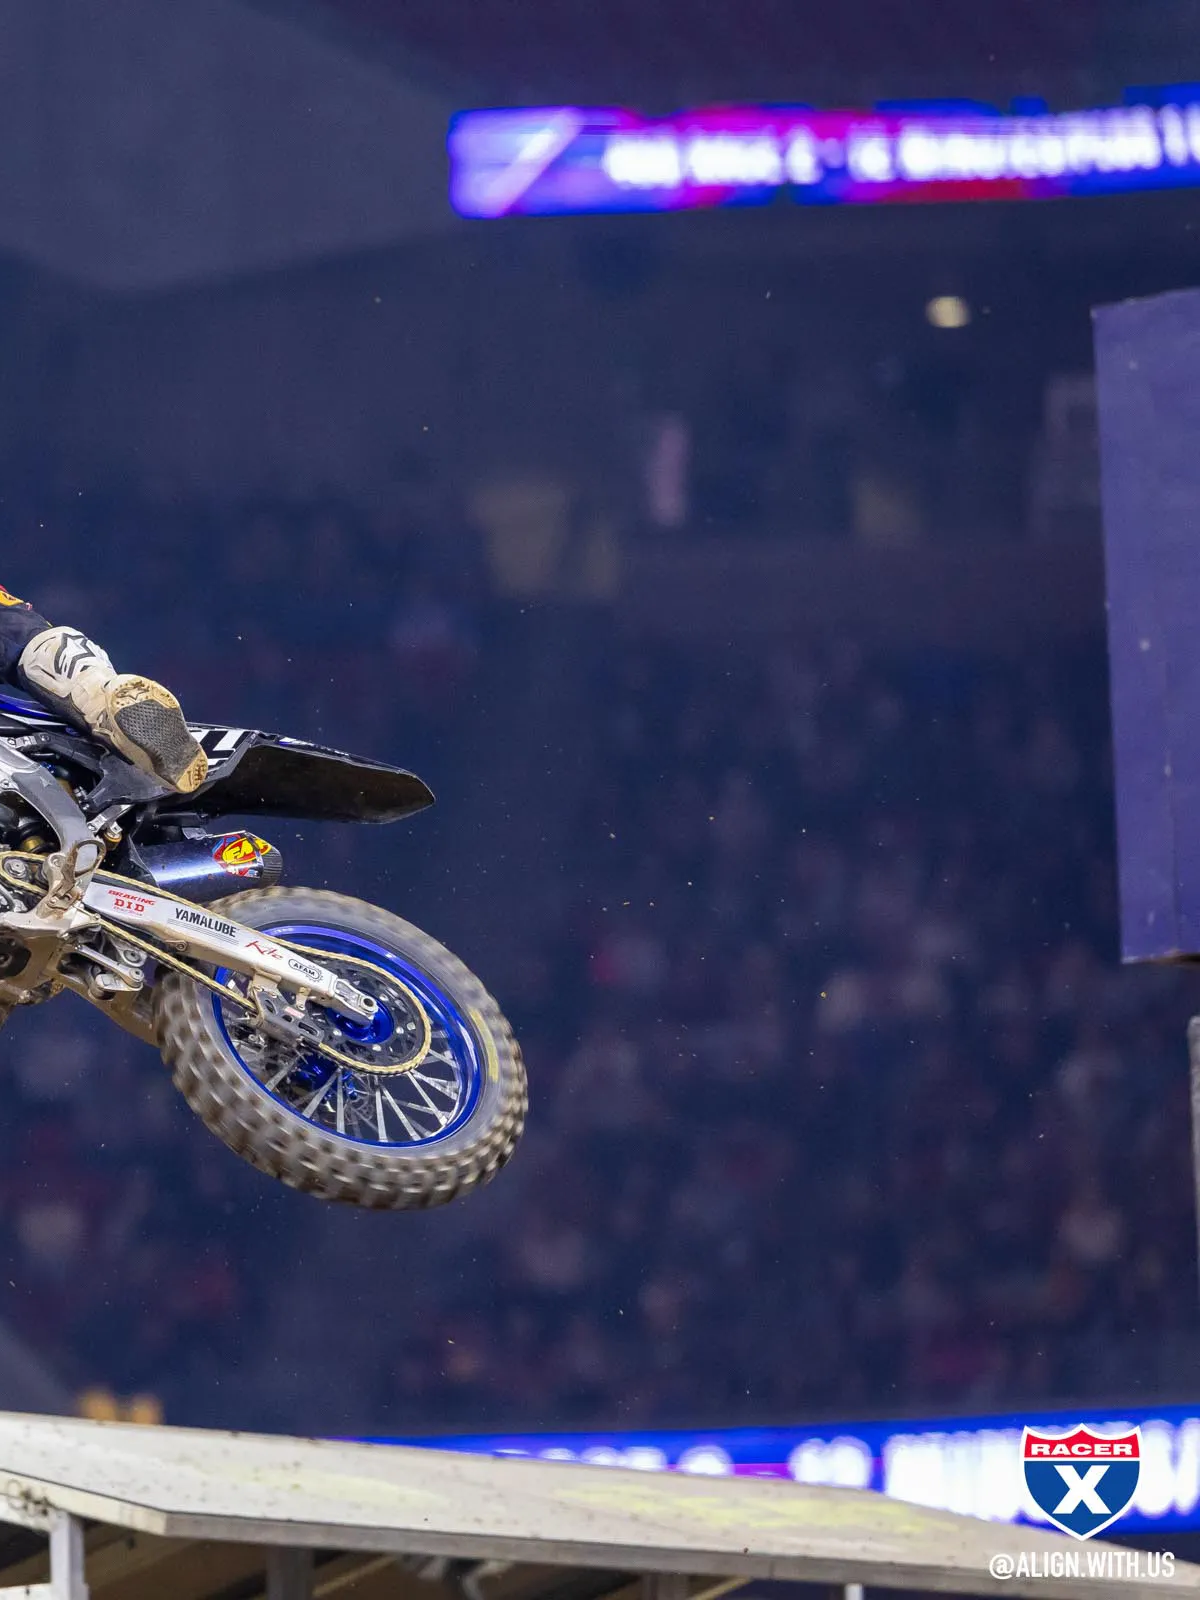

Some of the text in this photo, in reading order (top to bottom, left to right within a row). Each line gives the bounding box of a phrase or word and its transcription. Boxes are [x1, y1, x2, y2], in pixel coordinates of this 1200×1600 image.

[107, 889, 155, 906] BRAKING
[174, 908, 237, 938] YAMALUBE
[245, 940, 283, 960] Kite
[293, 963, 317, 977] AFAM
